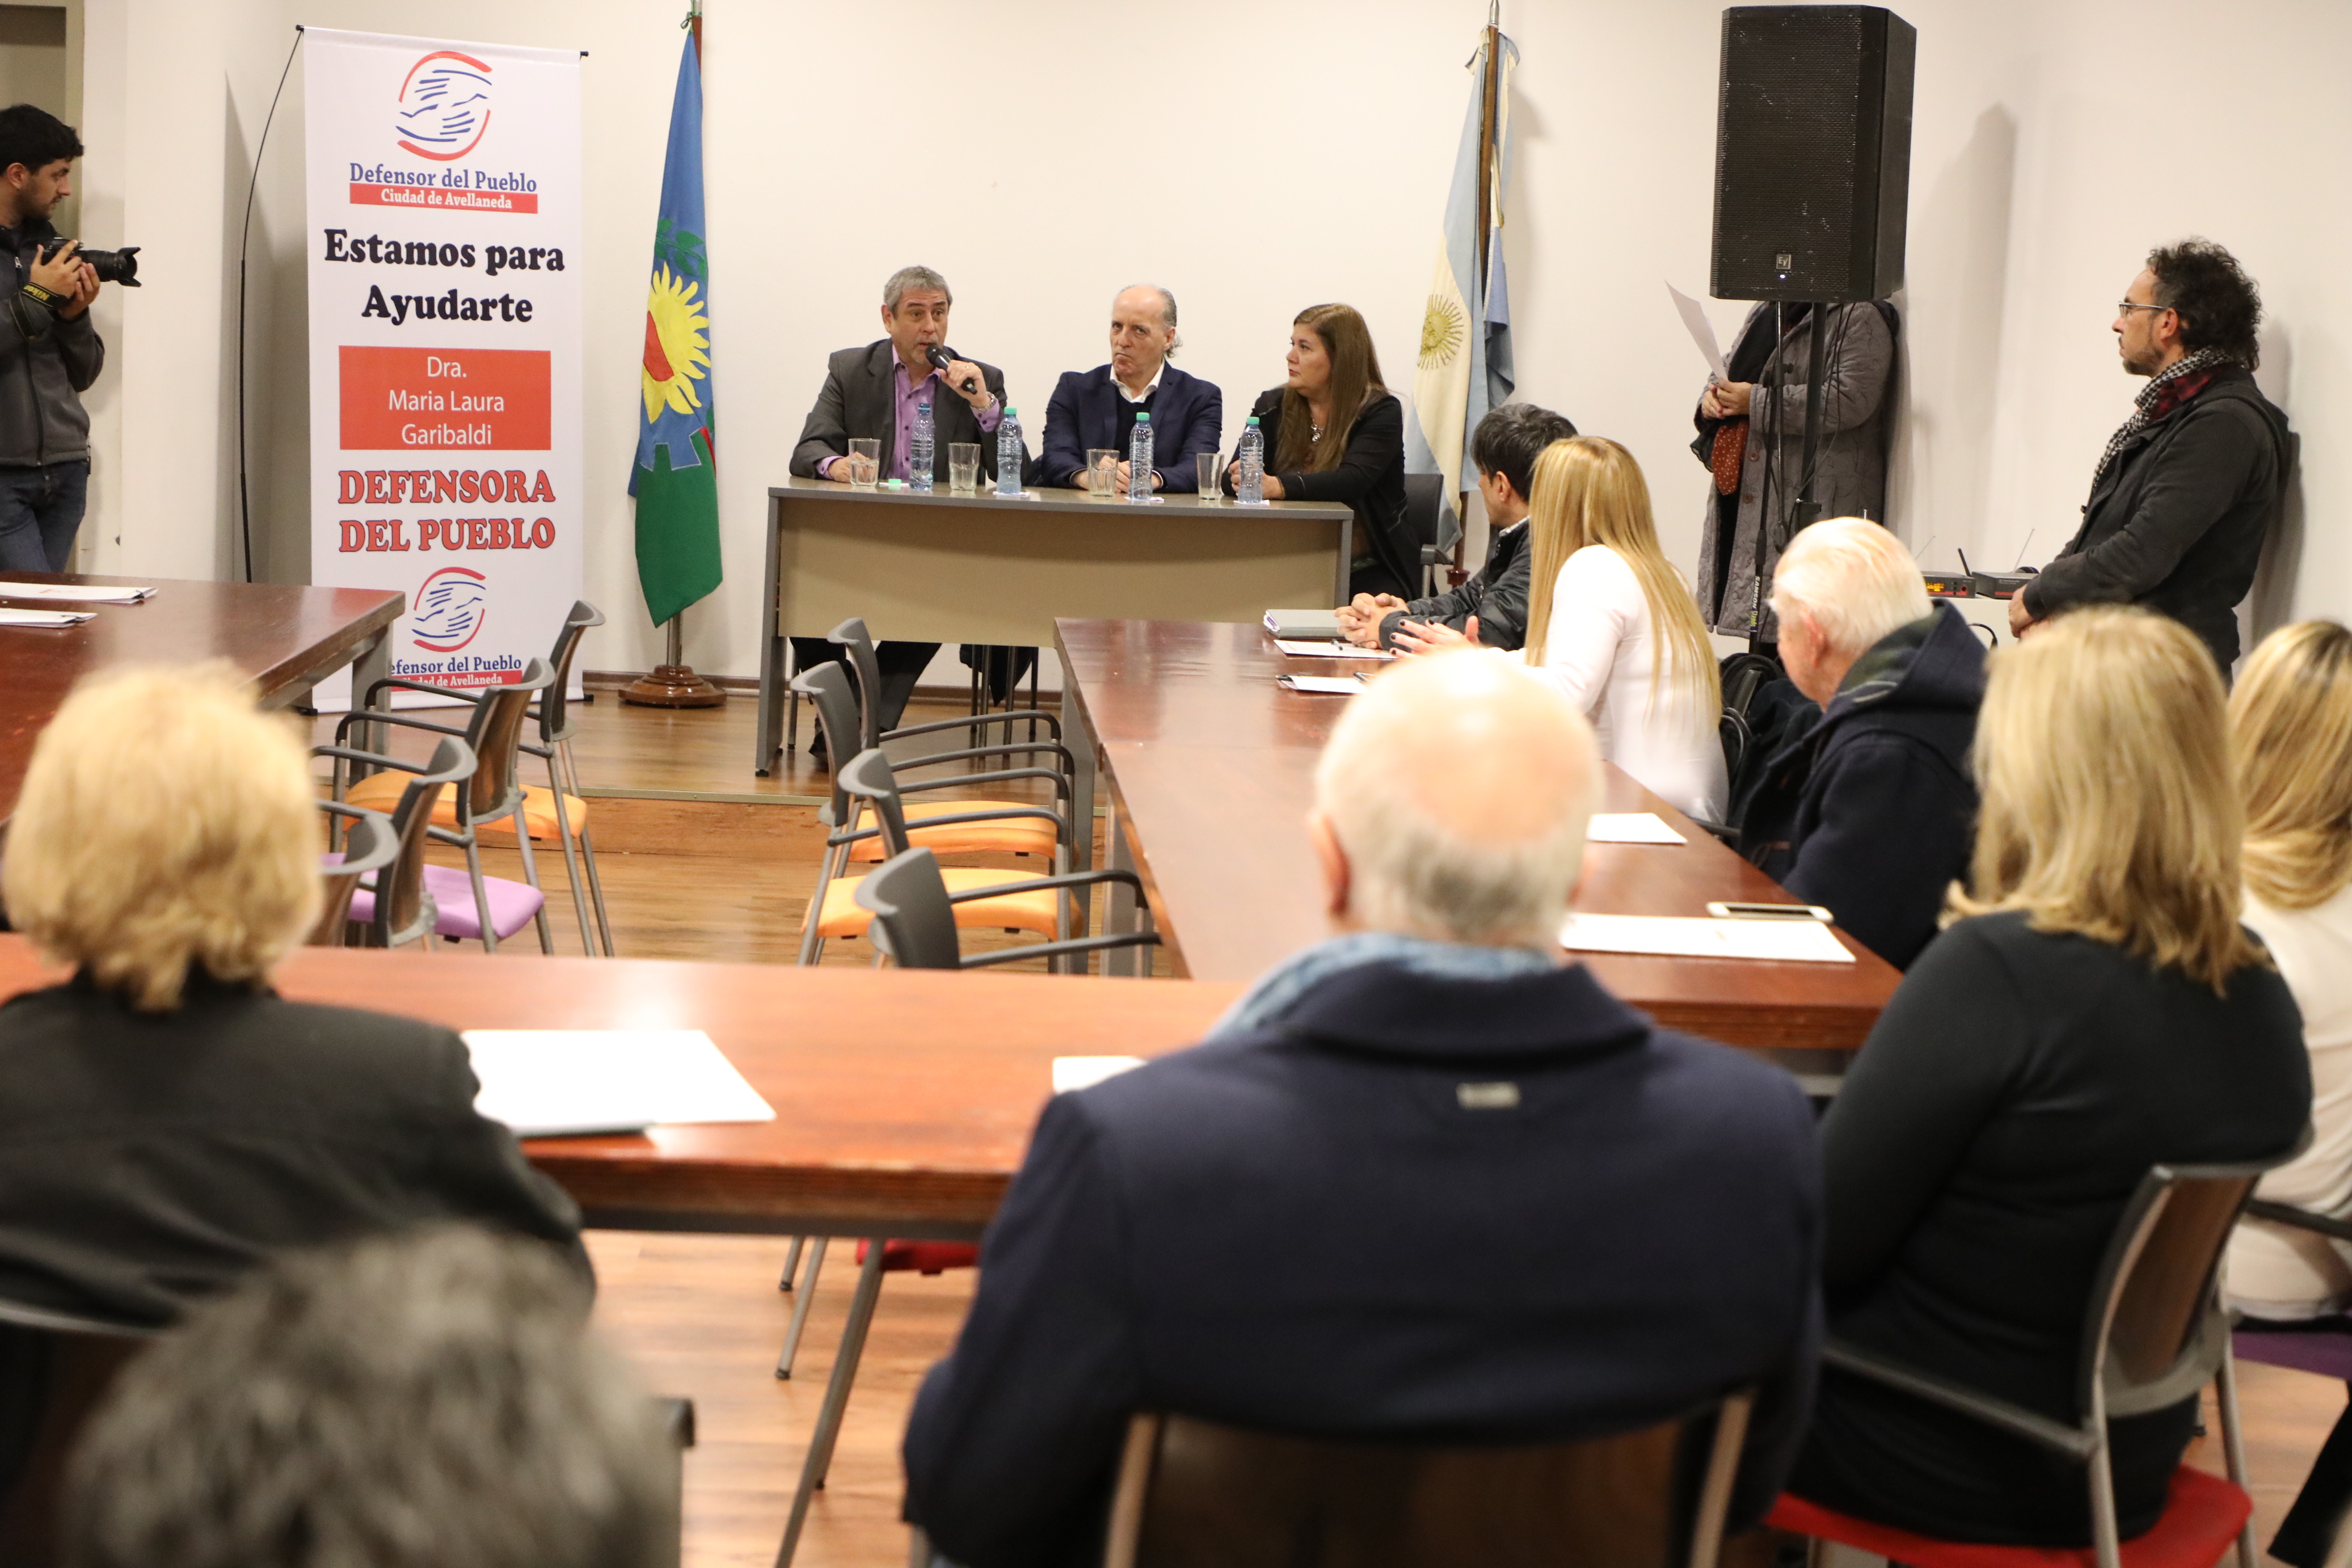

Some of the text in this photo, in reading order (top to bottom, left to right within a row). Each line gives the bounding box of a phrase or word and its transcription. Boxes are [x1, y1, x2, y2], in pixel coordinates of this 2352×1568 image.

[350, 162, 537, 192] Defensor del Pueblo
[380, 188, 512, 209] Ciudad de Avellaneda
[324, 229, 565, 276] Estamos para
[361, 285, 533, 326] Ayudarte
[427, 356, 467, 378] Dra.
[388, 389, 504, 411] Maria Laura
[401, 423, 492, 445] Garibaldi
[337, 469, 556, 504] DEFENSORA
[338, 517, 556, 553] DEL PUEBLO
[391, 654, 522, 674] efensor del Pueblo
[437, 675, 448, 687] de
[450, 673, 503, 686] Avellaneda
